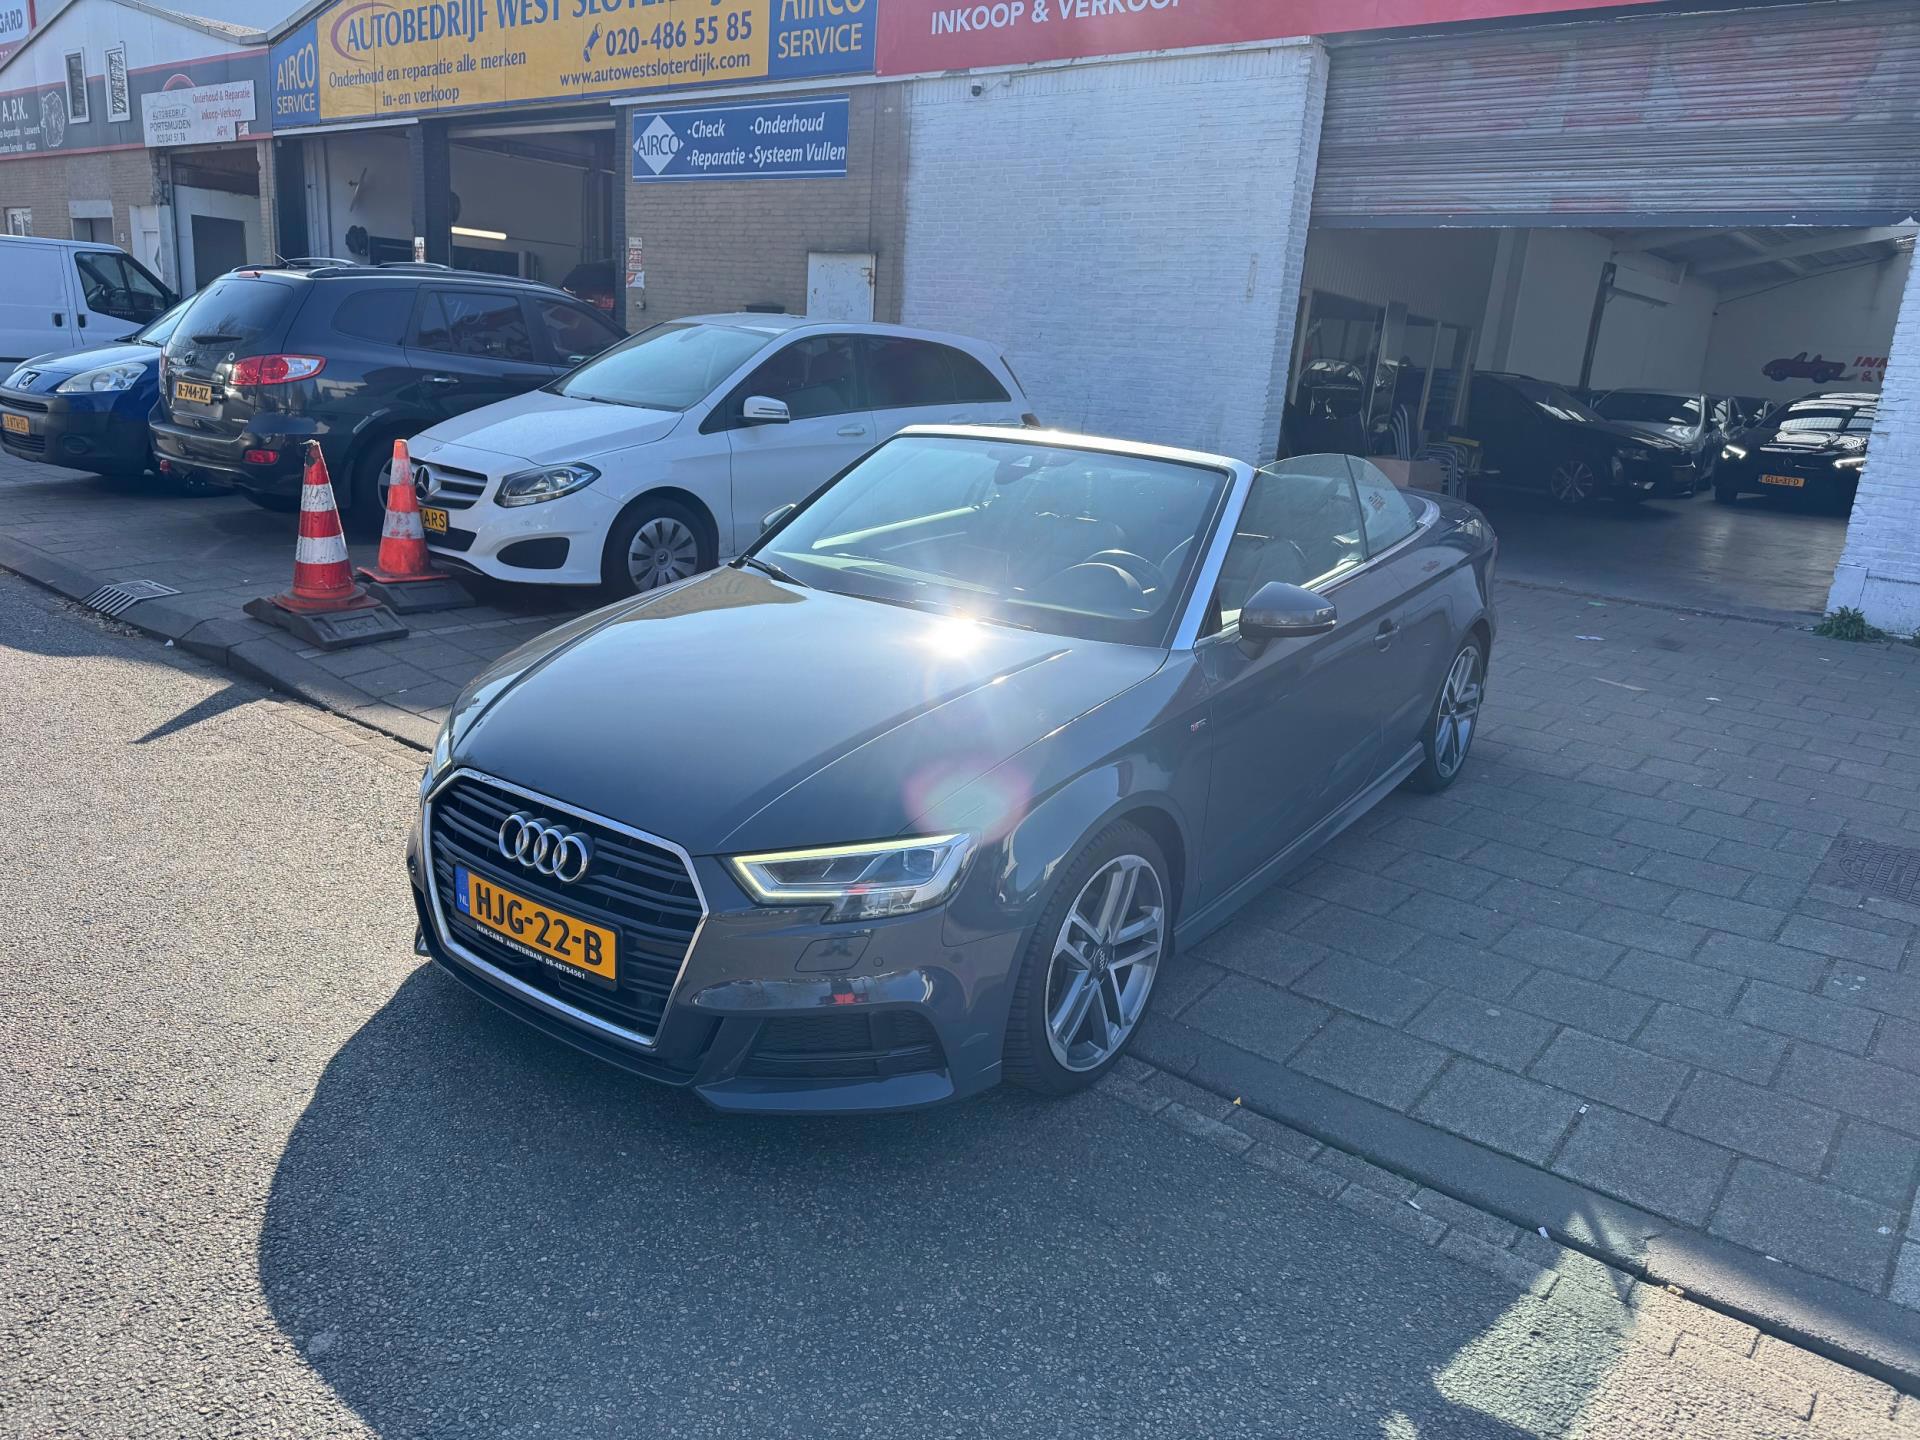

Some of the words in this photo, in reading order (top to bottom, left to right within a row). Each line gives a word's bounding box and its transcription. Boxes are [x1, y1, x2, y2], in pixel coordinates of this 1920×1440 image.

[346, 0, 489, 52] AUTOBEDRIJF
[605, 19, 687, 57] 020-486
[693, 15, 719, 46] 55
[726, 10, 752, 42] 85
[931, 1, 1025, 35] INKOOP
[1031, 0, 1050, 23] &
[777, 22, 864, 59] SERVICE
[276, 42, 316, 92] AIRCO
[328, 65, 385, 89] Onderhoud
[386, 67, 400, 81] en
[402, 57, 454, 82] reparatie
[456, 53, 477, 73] alle
[480, 50, 527, 70] merken
[559, 52, 751, 87] www.autowestsloterdijk.com
[276, 93, 316, 115] SERVICE
[414, 84, 461, 105] verkoop
[691, 119, 726, 138] Check
[754, 111, 825, 134] Onderhoud
[637, 134, 681, 156] AIRCO
[690, 147, 746, 170] Reparatie
[752, 145, 804, 168] Systeem
[806, 141, 846, 161] Vullen
[458, 893, 469, 908] NL
[475, 882, 602, 966] HJG-22-B
[506, 940, 543, 963] AMSTERDAM
